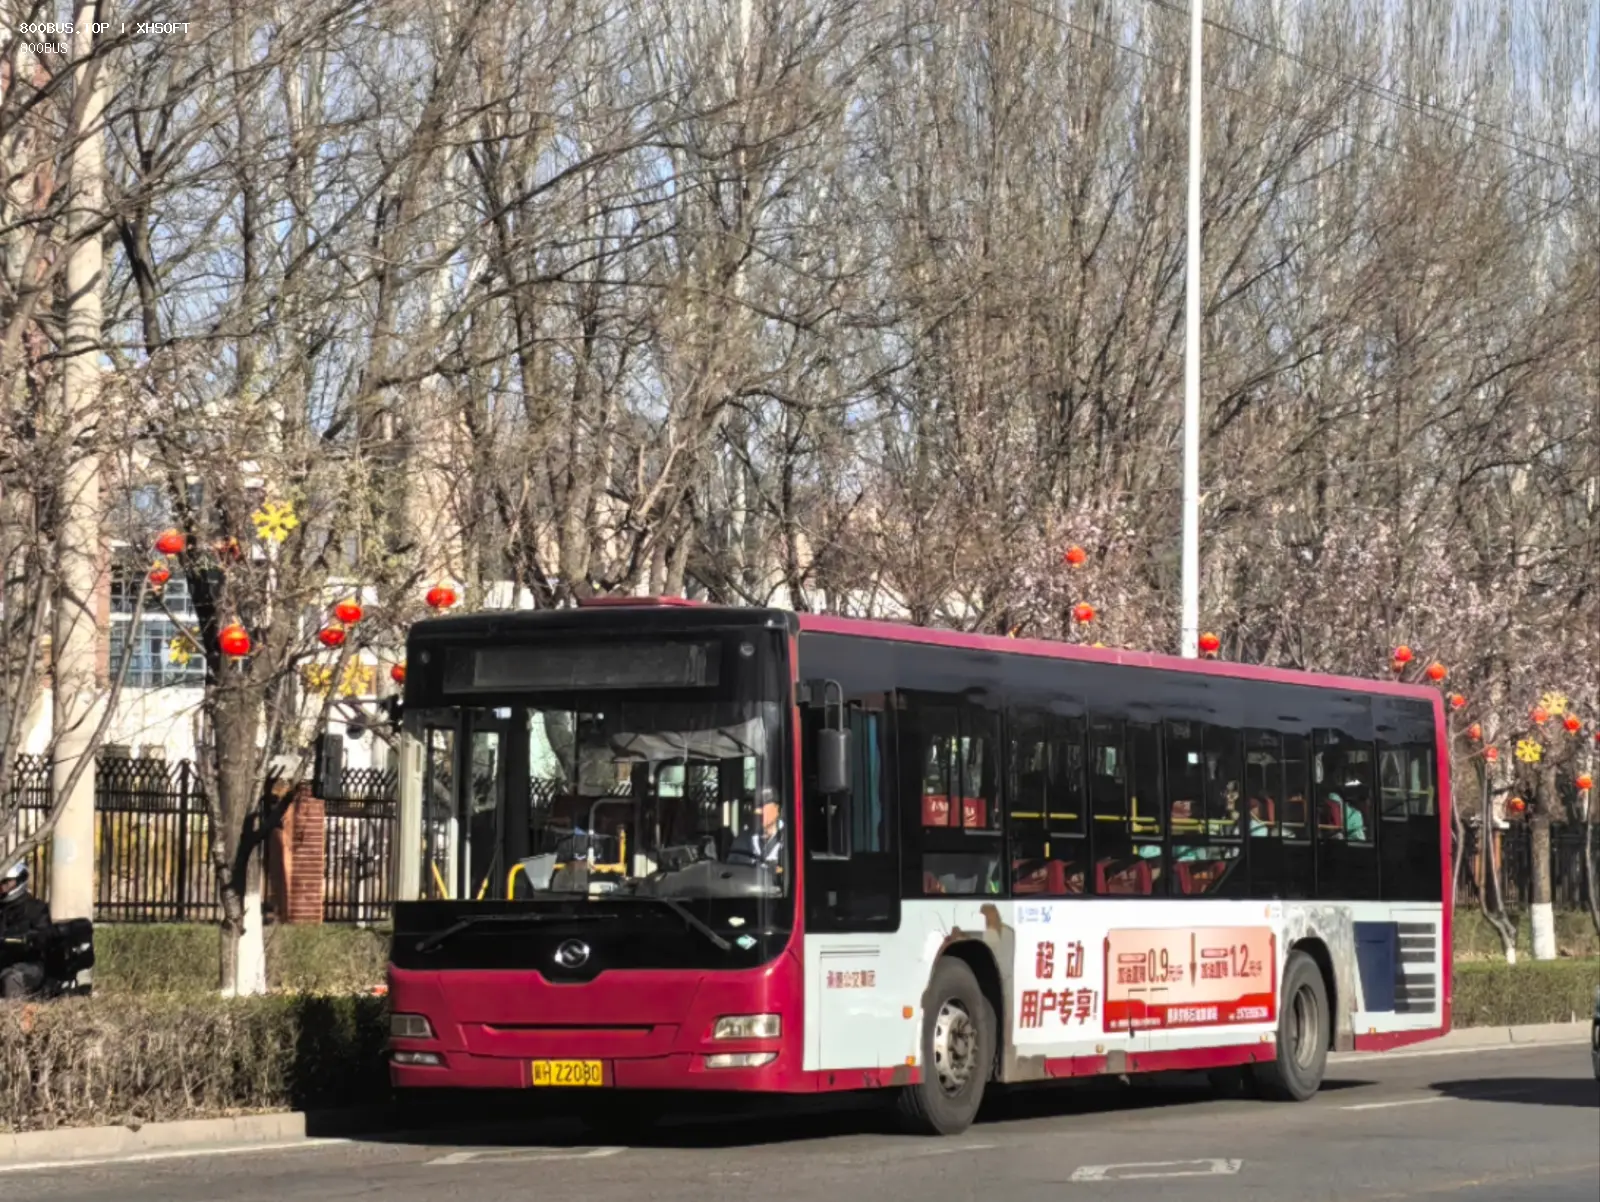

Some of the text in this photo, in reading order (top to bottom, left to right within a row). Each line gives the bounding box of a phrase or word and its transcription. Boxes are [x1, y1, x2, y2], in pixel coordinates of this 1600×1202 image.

[1036, 939, 1085, 979] 移动
[1148, 948, 1169, 983] 0.9
[1229, 944, 1249, 977] 1.2
[555, 1063, 600, 1082] Z2080
